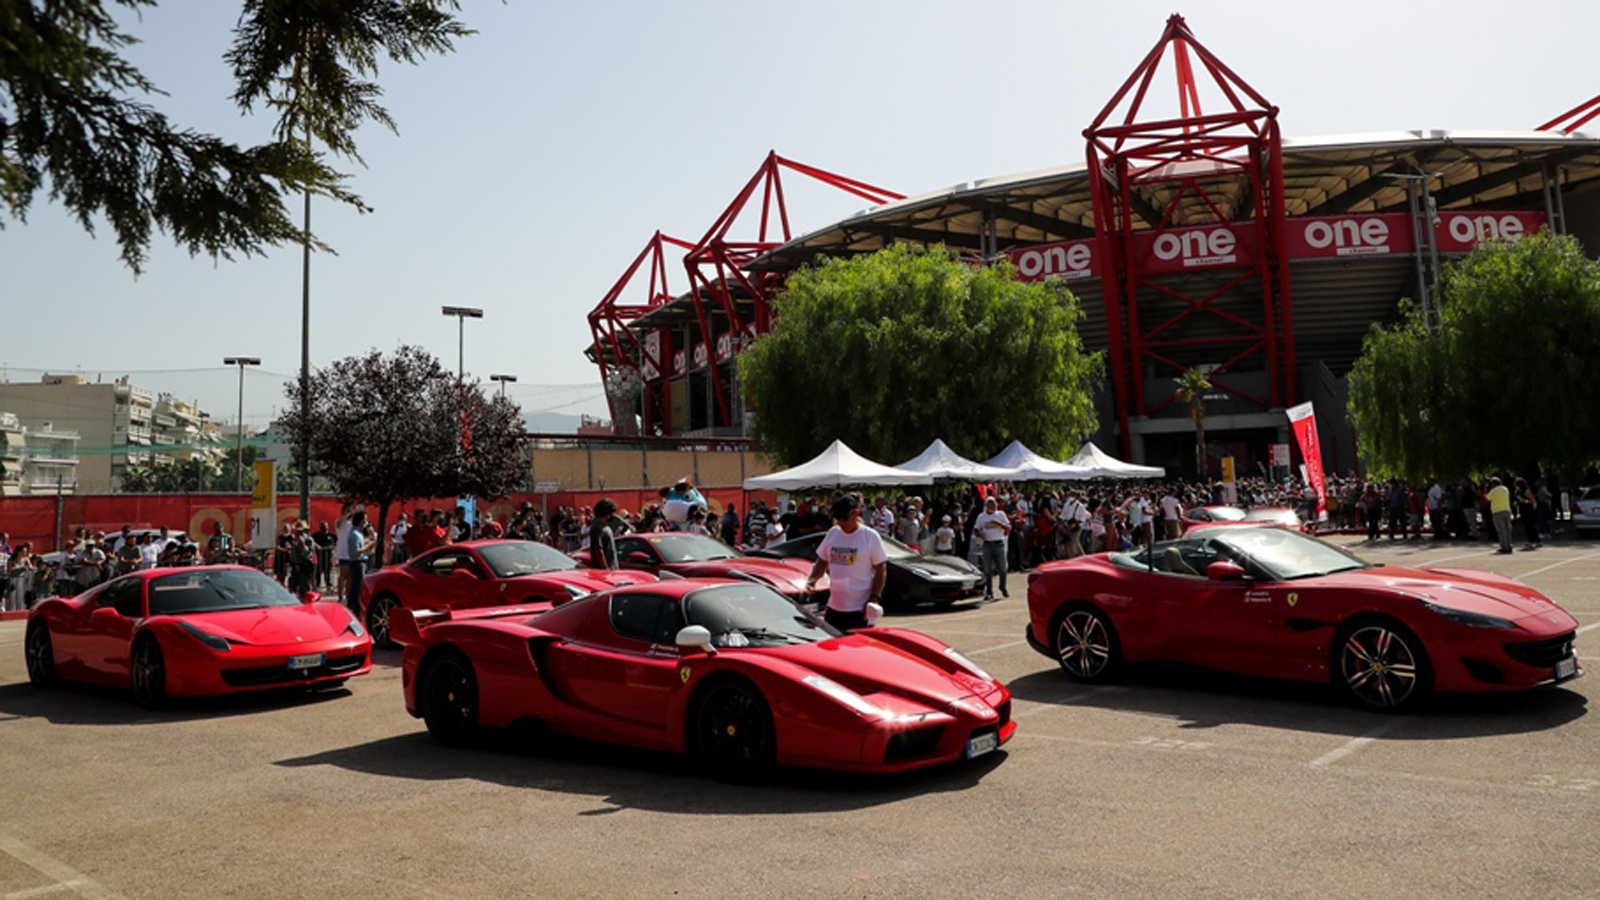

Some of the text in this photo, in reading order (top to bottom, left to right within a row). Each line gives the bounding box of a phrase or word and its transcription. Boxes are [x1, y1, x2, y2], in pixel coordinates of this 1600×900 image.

[1153, 228, 1236, 260] one
[1303, 218, 1389, 248] one
[1449, 215, 1523, 243] one
[1019, 244, 1091, 276] one
